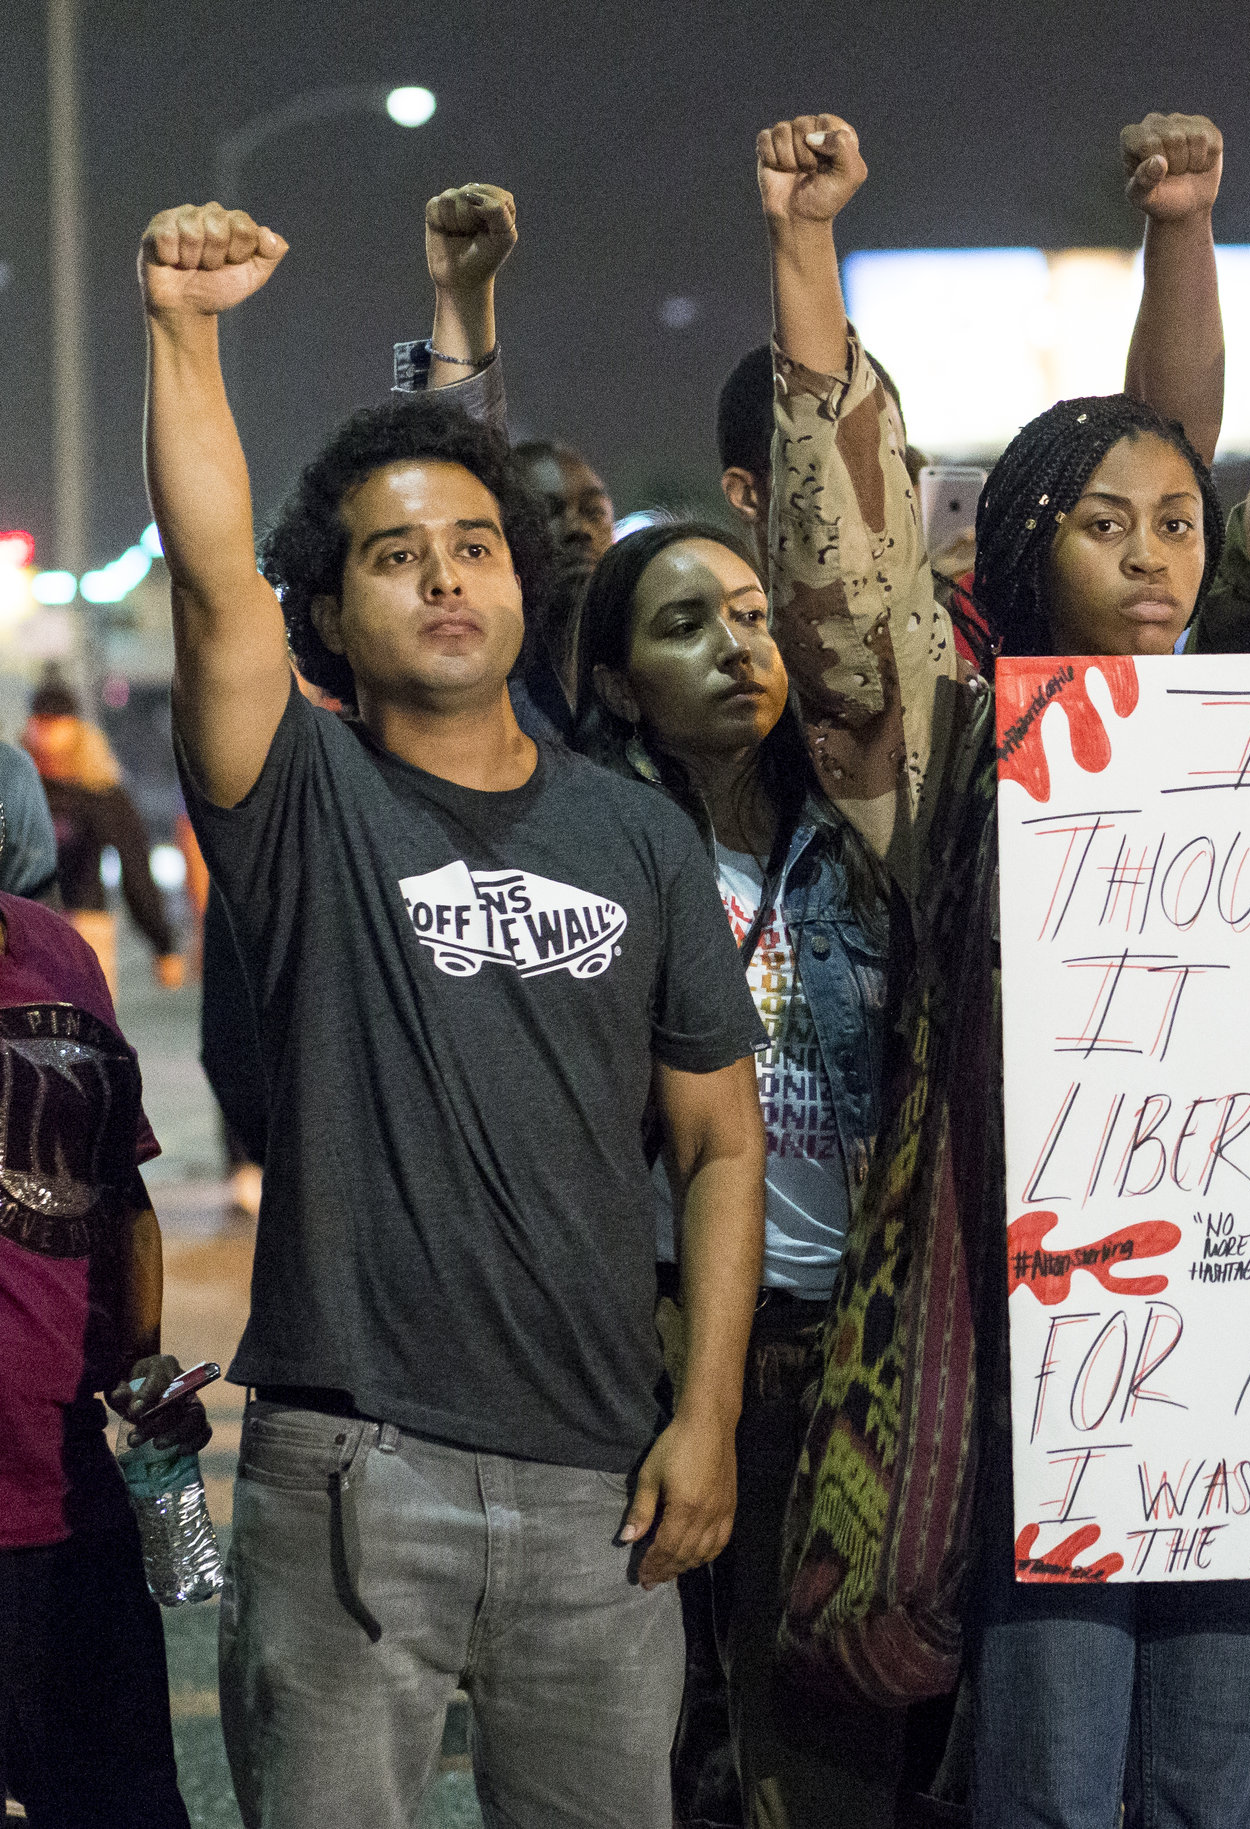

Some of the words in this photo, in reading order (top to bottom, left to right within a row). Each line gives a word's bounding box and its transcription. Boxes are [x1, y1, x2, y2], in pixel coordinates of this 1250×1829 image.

[1054, 948, 1230, 1063] IT
[1029, 1301, 1189, 1445] FOR
[1036, 1444, 1132, 1525] I
[1126, 1524, 1230, 1576] THE
